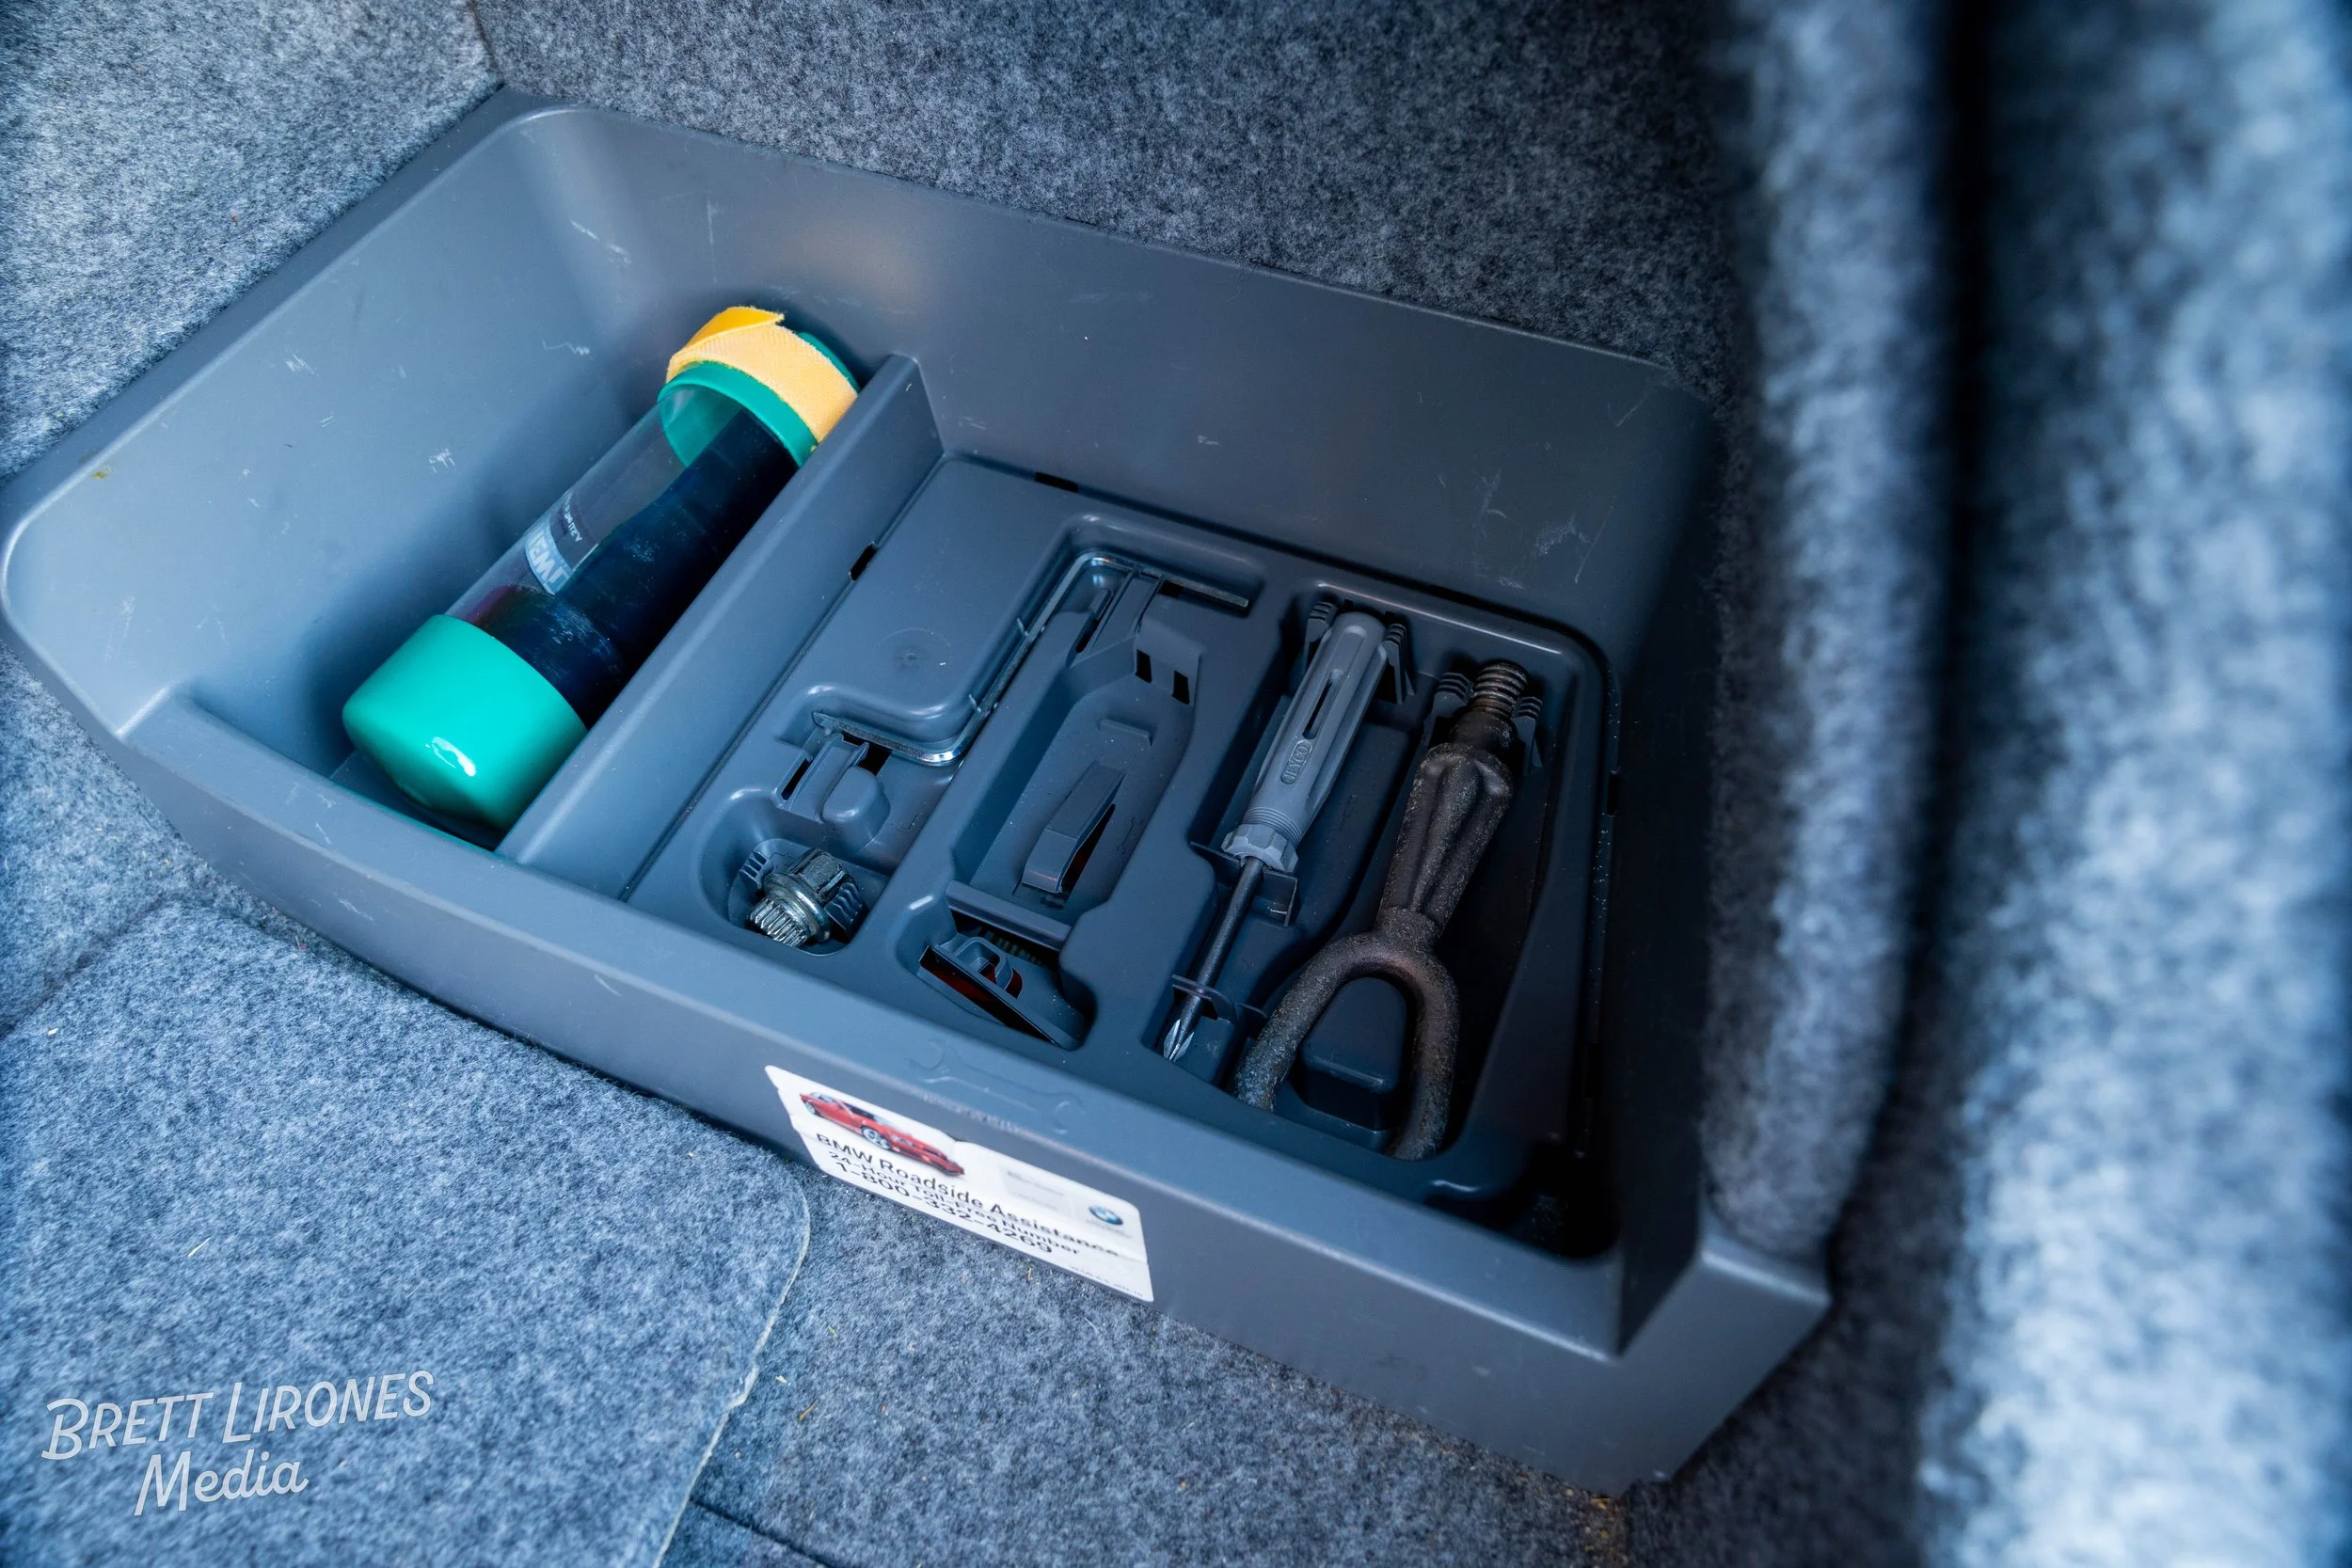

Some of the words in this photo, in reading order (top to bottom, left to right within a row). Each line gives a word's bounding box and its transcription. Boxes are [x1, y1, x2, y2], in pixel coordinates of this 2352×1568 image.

[816, 1132, 873, 1164] BMW
[879, 1158, 983, 1209] Roadside
[990, 1203, 1119, 1257] Assistance
[828, 1150, 905, 1186] 24-Hour
[913, 1184, 997, 1223] Toll-Free
[1002, 1219, 1080, 1256] Number
[835, 1162, 1053, 1253] 1-800-332-4269
